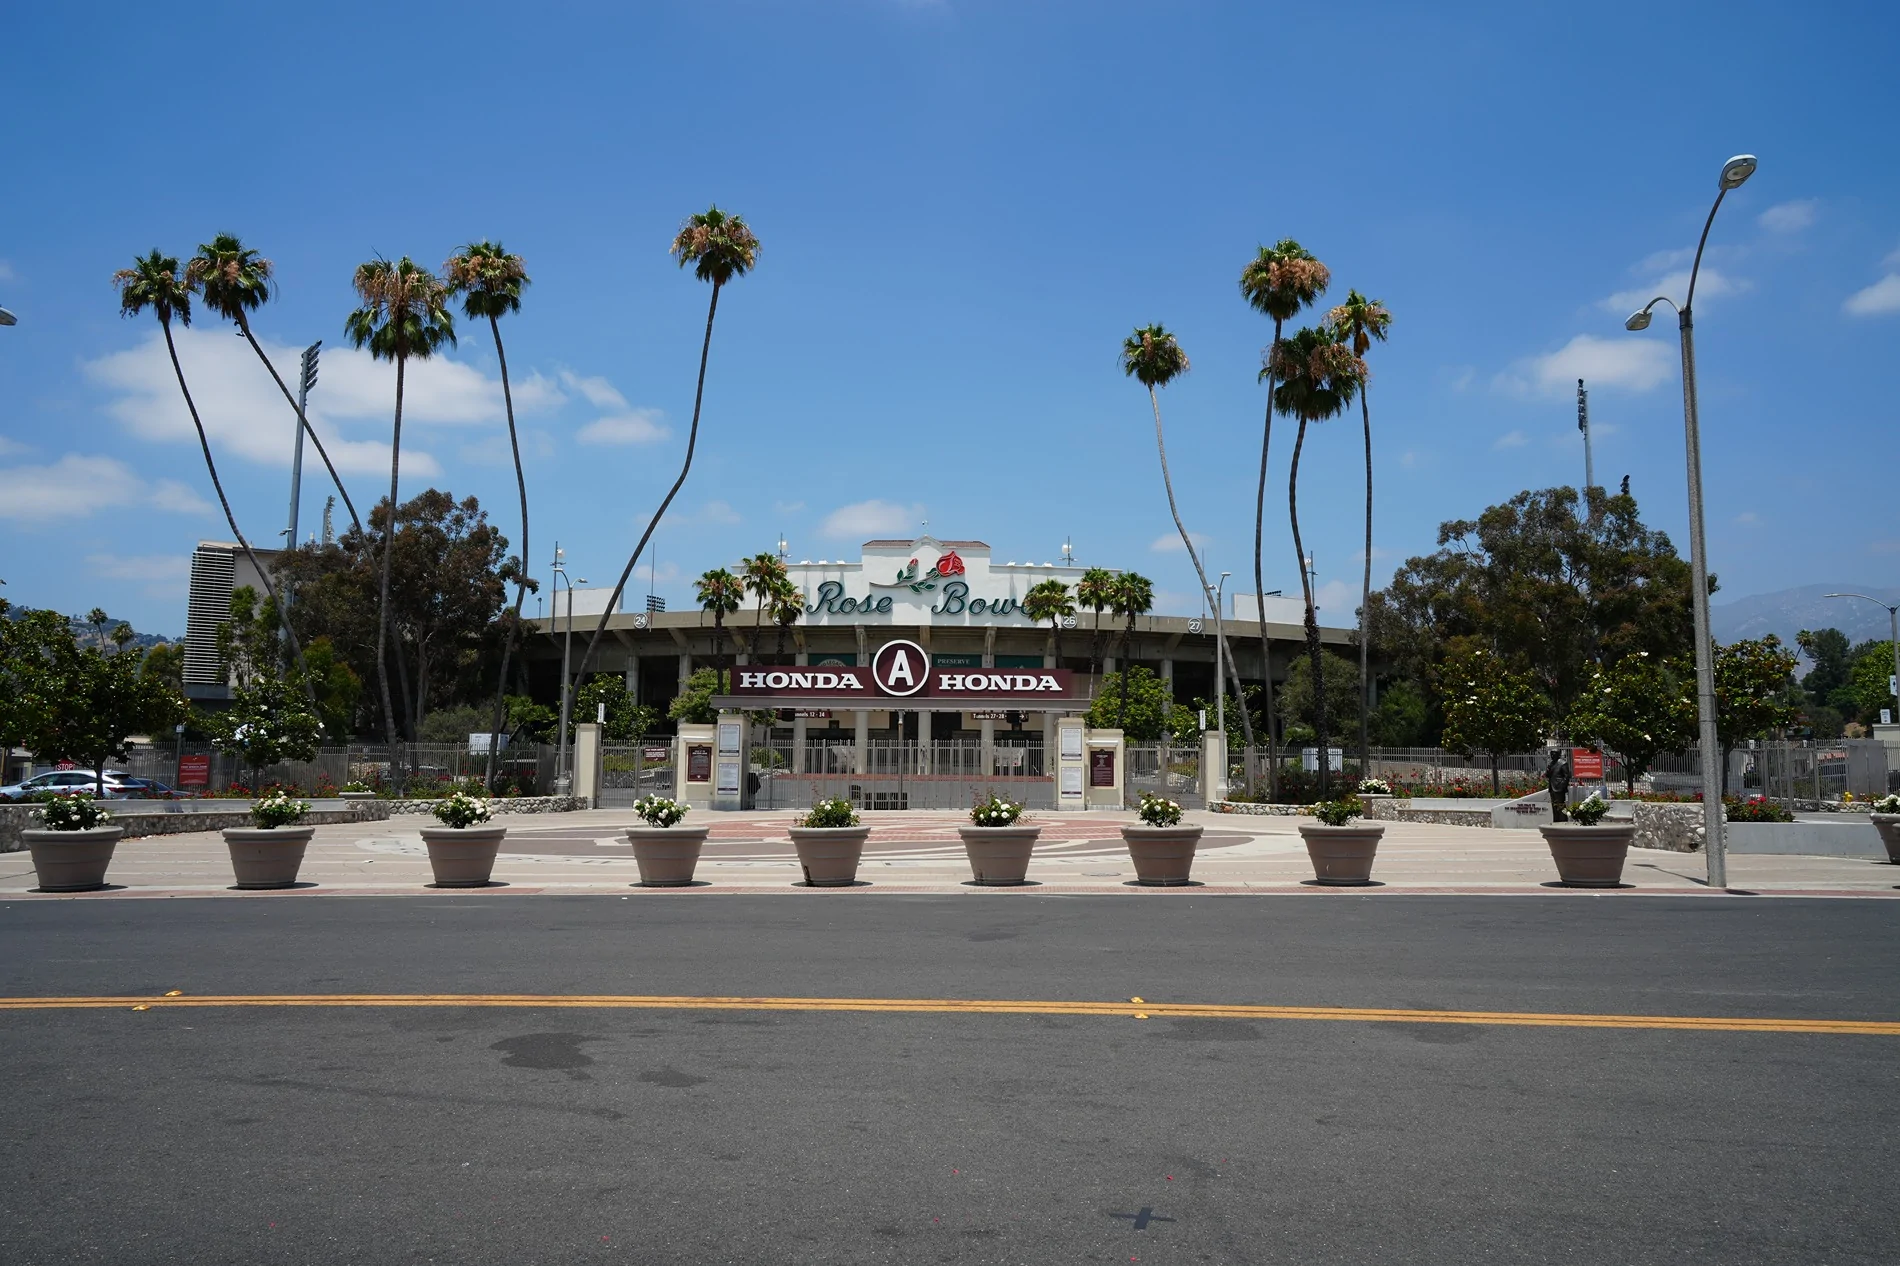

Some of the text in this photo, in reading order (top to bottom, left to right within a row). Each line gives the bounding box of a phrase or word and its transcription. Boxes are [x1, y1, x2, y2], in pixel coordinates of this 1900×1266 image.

[806, 581, 893, 615] Rose
[634, 616, 646, 626] 24
[1063, 616, 1076, 626] 26
[1189, 621, 1200, 630] 27
[888, 650, 913, 686] A
[740, 672, 863, 689] HONDA
[939, 674, 1063, 691] HONDA
[57, 763, 74, 771] STOP
